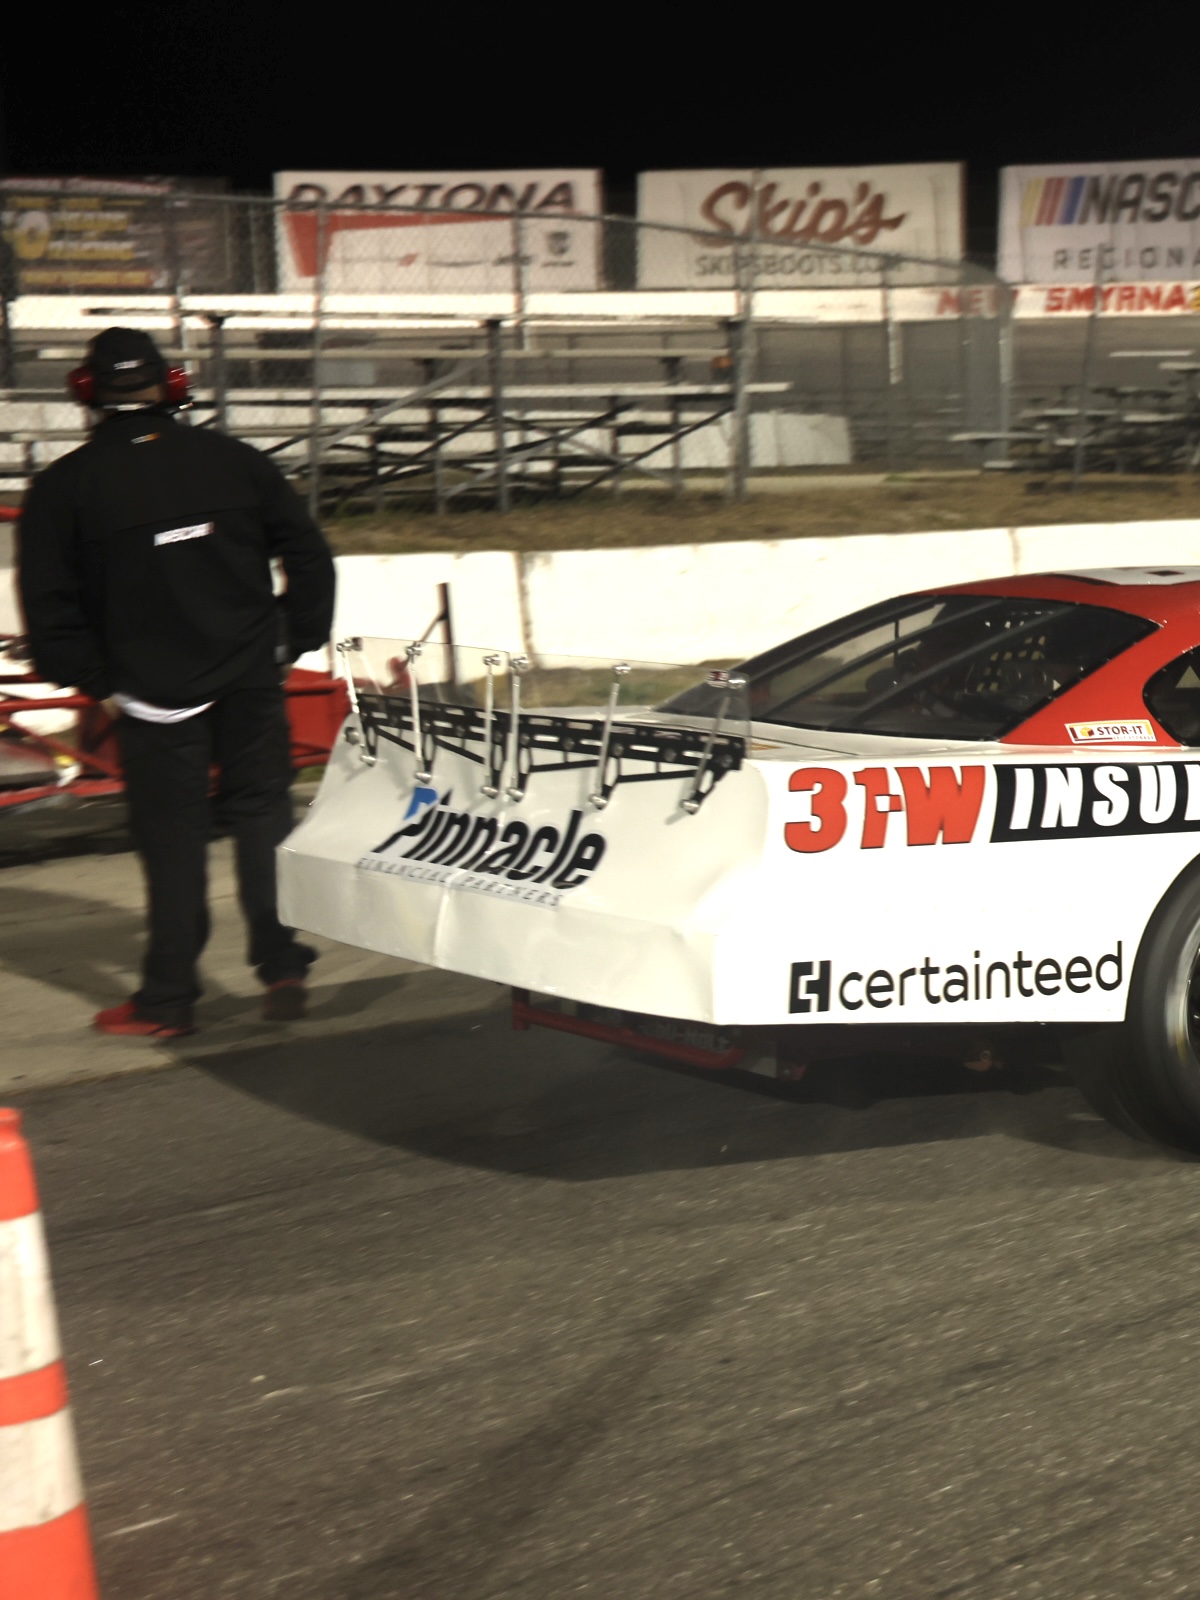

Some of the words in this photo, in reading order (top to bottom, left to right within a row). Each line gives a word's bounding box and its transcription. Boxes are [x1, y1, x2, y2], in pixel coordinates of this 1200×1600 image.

[286, 181, 575, 212] DAYTONA
[692, 180, 908, 249] Skip's
[1043, 283, 1192, 314] SMYRNA
[1097, 726, 1143, 735] STOR-IT
[371, 787, 606, 889] Pinnacle
[784, 764, 986, 853] 31-W
[838, 941, 1123, 1010] certainteed
